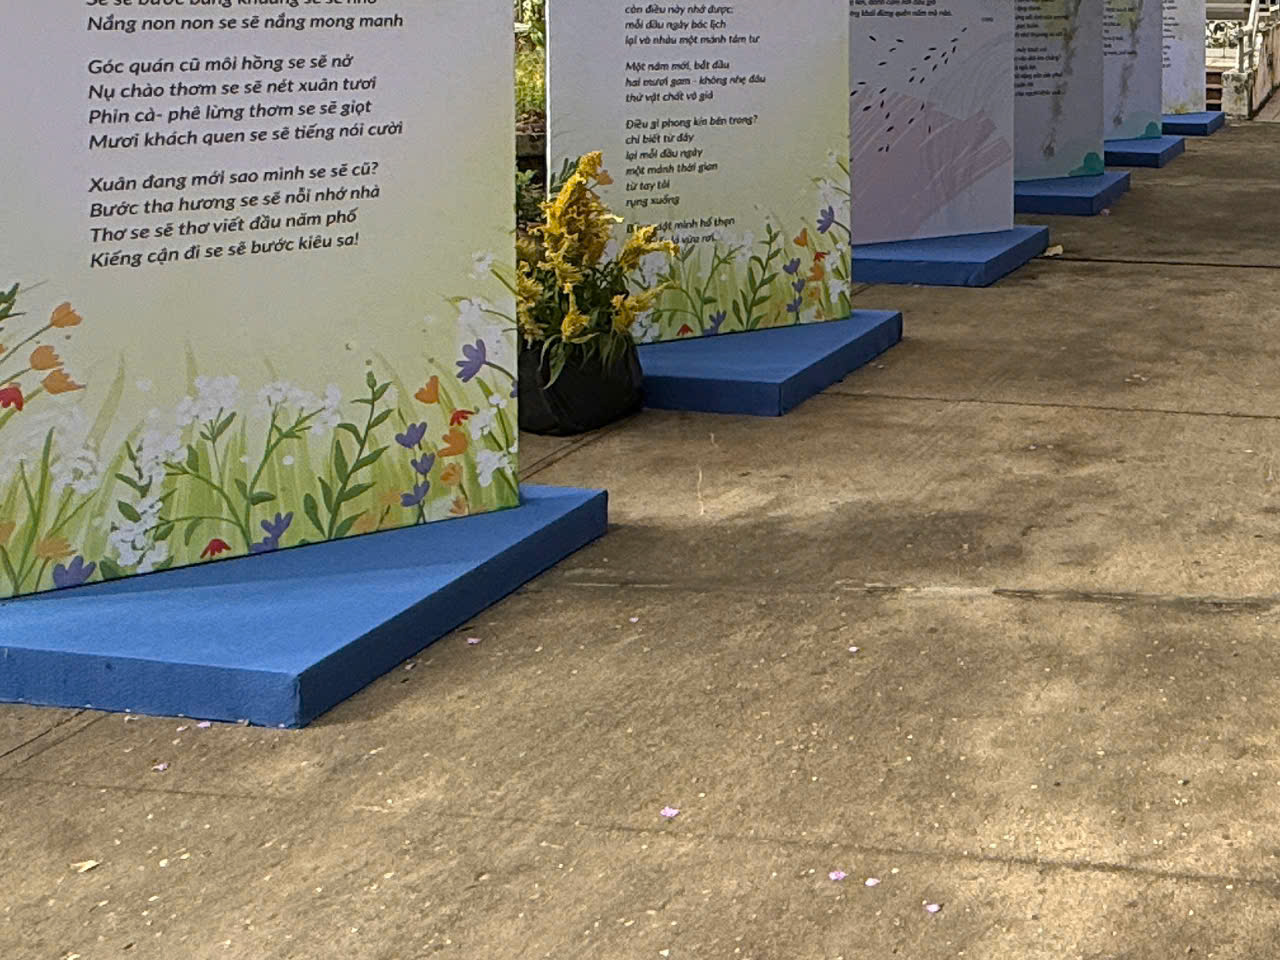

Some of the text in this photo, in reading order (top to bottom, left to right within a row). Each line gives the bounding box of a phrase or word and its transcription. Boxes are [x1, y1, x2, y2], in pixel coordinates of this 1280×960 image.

[87, 12, 403, 33] Nắng non non se sẽ nắng mong manh
[91, 232, 358, 268] Kiếng cận đi se sẽ bước kiêu sa!
